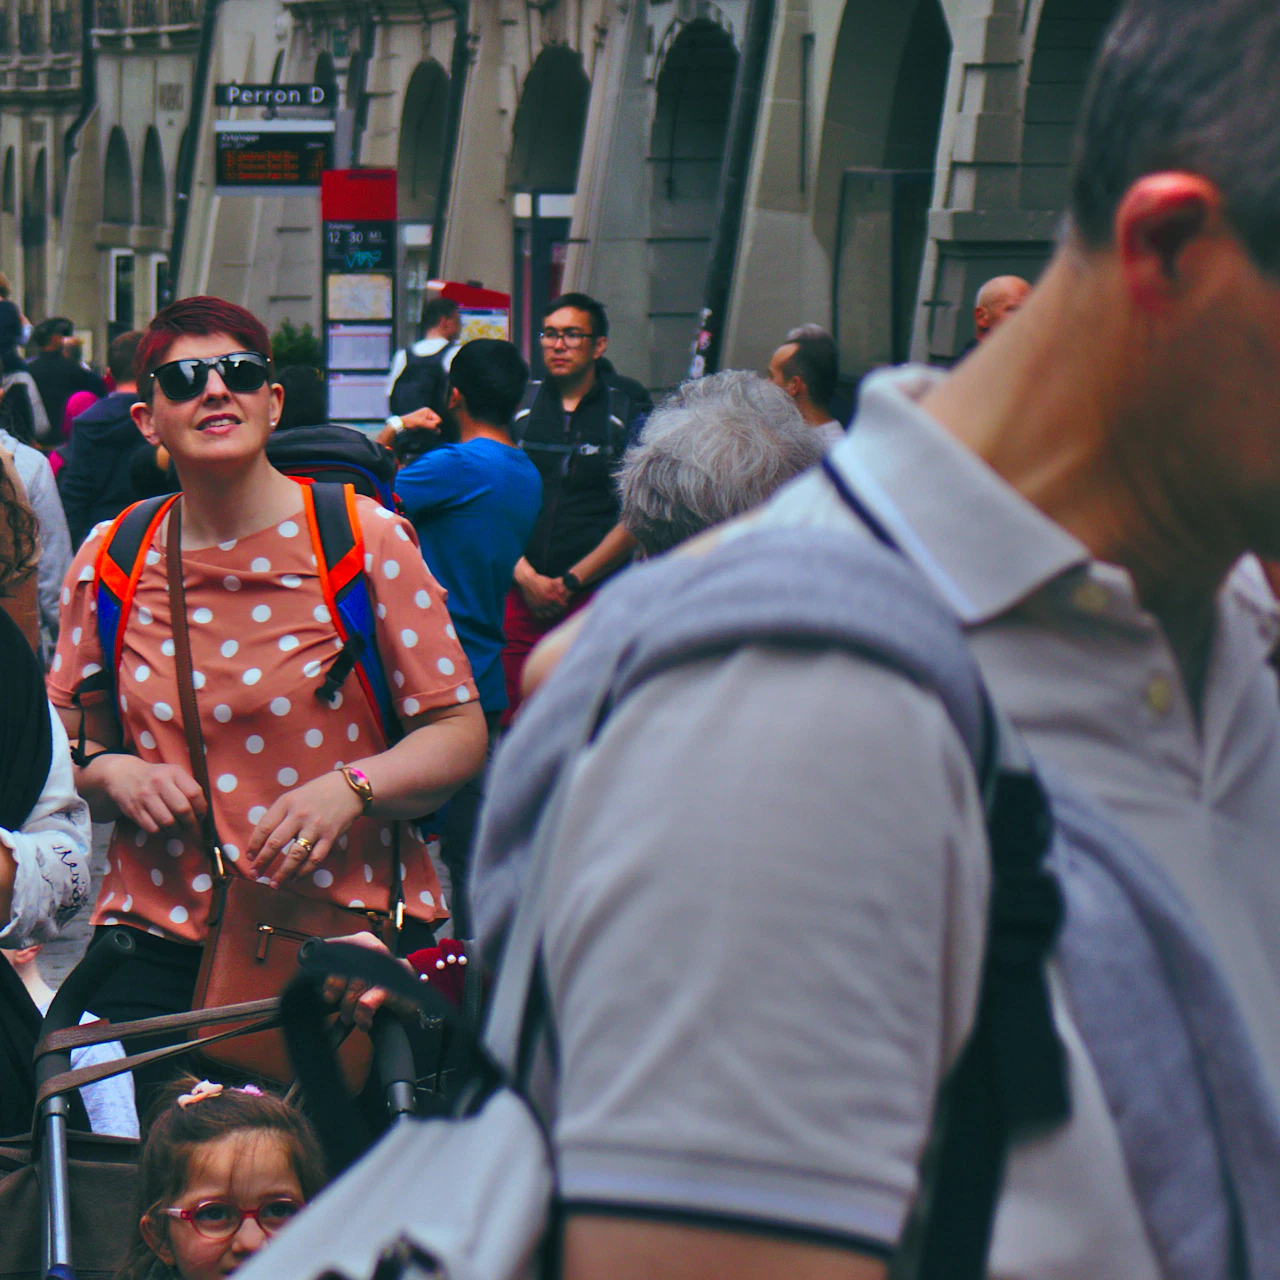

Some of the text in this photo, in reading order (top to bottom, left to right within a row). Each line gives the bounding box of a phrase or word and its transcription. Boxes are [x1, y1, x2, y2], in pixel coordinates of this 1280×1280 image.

[227, 85, 326, 105] Perron D
[327, 231, 340, 244] 12
[348, 231, 364, 244] 30
